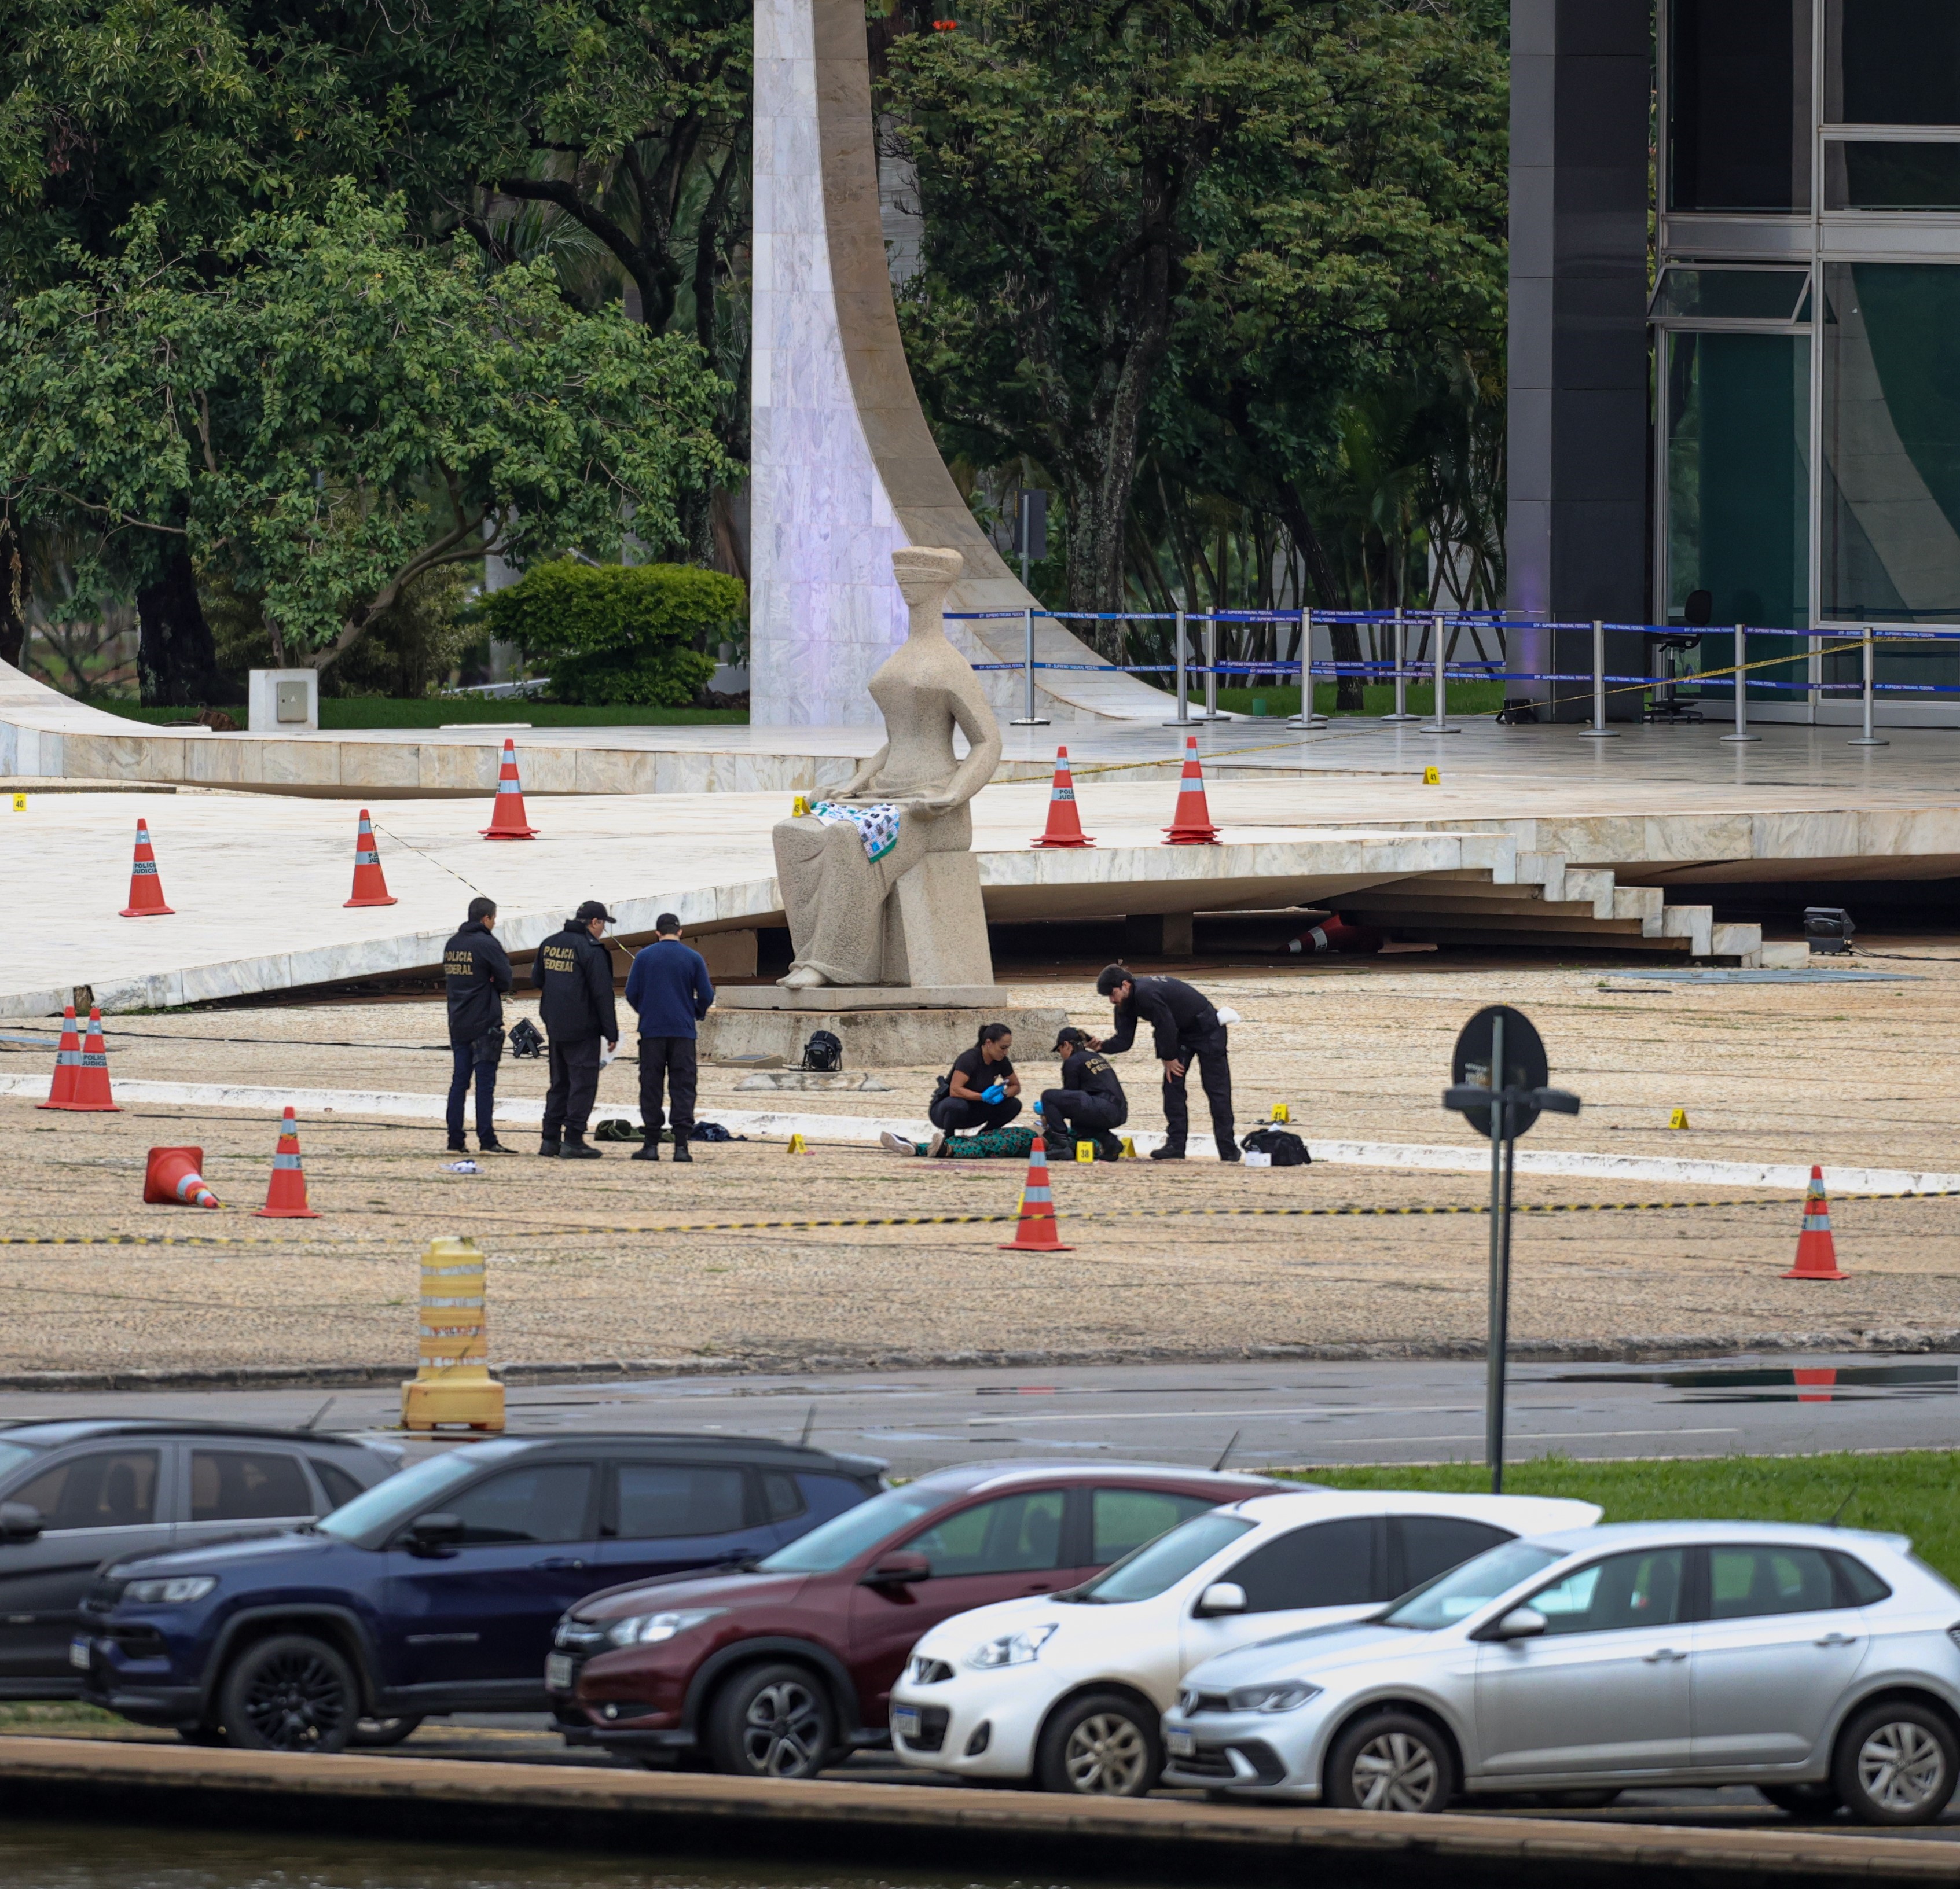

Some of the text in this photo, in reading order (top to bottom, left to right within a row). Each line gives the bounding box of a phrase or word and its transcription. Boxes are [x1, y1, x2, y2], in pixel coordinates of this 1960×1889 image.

[16, 800, 24, 808] 40
[794, 804, 799, 813] 45
[1273, 1112, 1281, 1121] 41
[1080, 1149, 1089, 1158] 38
